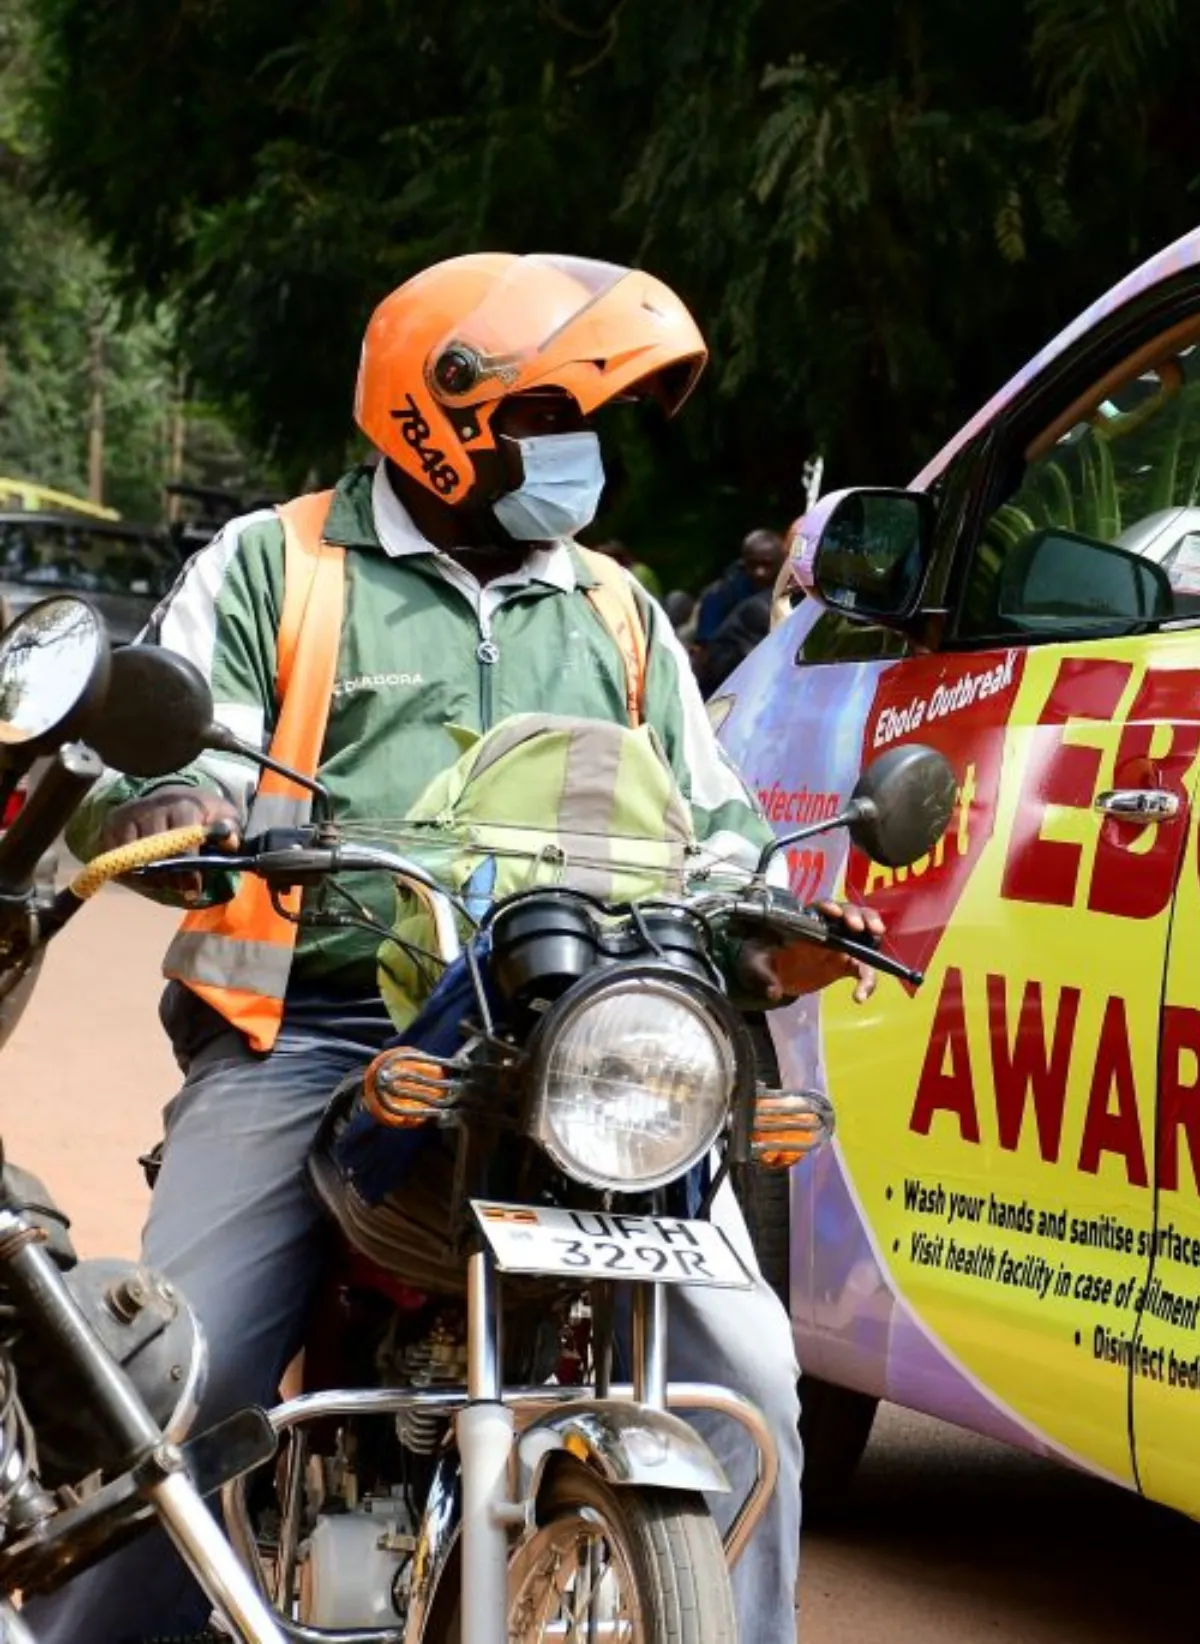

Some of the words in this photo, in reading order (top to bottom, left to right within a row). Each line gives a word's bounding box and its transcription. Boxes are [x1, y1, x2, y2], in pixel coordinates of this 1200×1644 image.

[388, 392, 461, 496] 7848
[872, 696, 927, 749] Ebola
[926, 651, 1019, 722] Outbreak
[903, 1178, 947, 1215] Wash
[947, 1191, 986, 1225] your
[988, 1192, 1034, 1235] hands
[1036, 1209, 1068, 1242] and
[1069, 1213, 1134, 1255] sanitise
[552, 1236, 716, 1279] 329R
[909, 1231, 944, 1268] Visit
[945, 1237, 996, 1281] health
[995, 1250, 1055, 1301] facility
[1053, 1262, 1073, 1298] in
[1073, 1270, 1112, 1305] case
[1114, 1275, 1137, 1311] of
